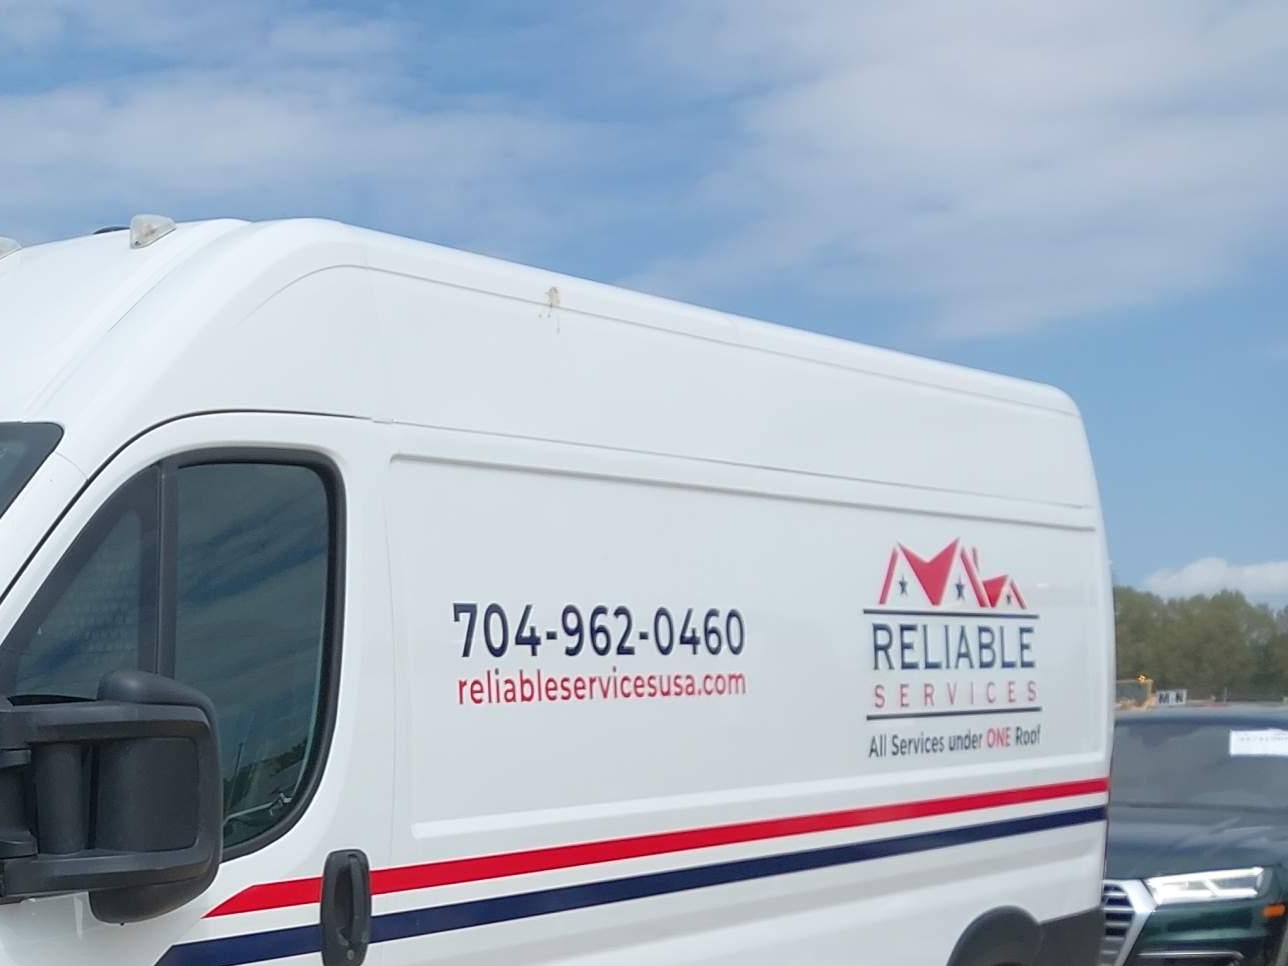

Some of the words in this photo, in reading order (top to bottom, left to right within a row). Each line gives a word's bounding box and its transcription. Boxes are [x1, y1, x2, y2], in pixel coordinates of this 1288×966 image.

[453, 602, 745, 657] 704-962-0460
[872, 623, 1036, 670] RELIABLE
[458, 666, 746, 704] reliableservicesusa.com
[874, 681, 1037, 708] SERVICES
[868, 735, 887, 758] All
[891, 731, 944, 756] Services
[948, 729, 983, 752] under
[986, 727, 1011, 748] ONE
[1015, 724, 1041, 746] Roof
